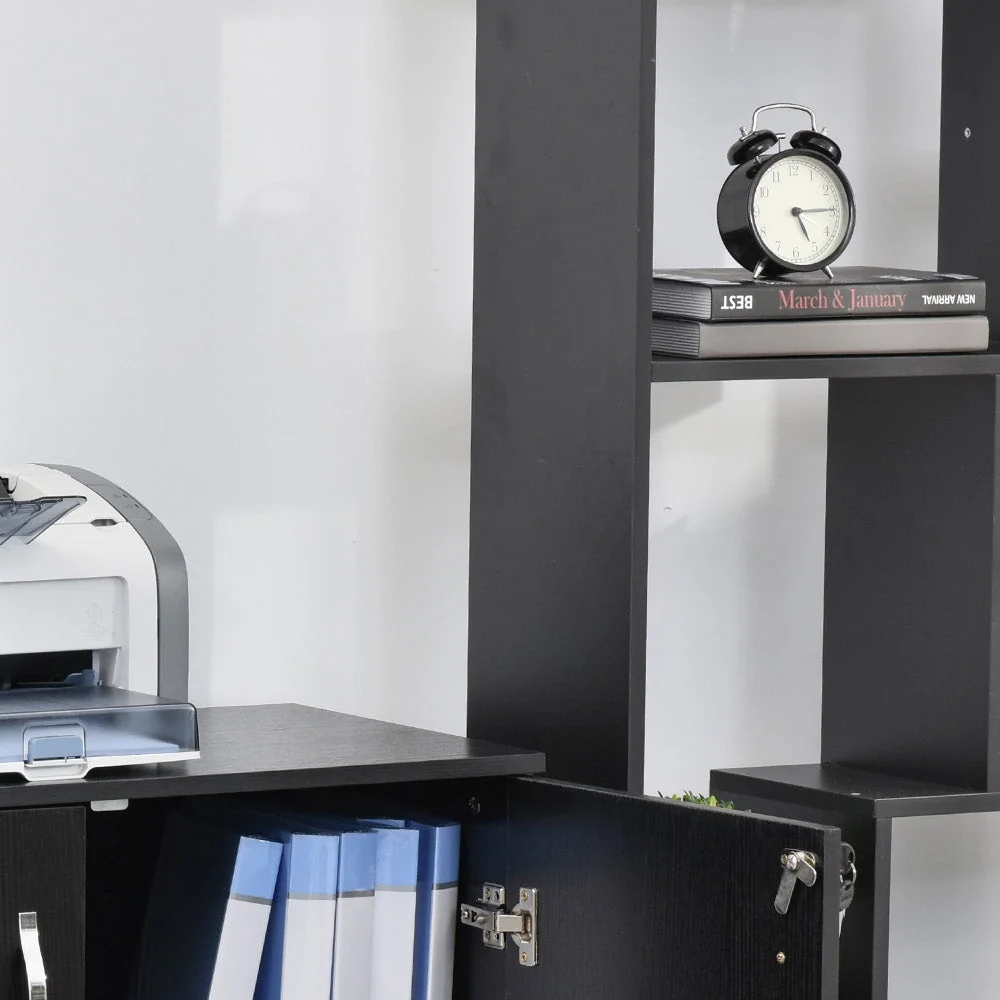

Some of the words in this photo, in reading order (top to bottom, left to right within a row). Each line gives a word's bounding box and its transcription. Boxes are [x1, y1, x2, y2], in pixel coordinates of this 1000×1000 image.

[789, 165, 799, 176] 12
[772, 171, 780, 183] 11
[759, 186, 769, 198] 10
[822, 185, 829, 196] 2
[822, 225, 829, 237] 4
[775, 241, 781, 252] 7
[792, 246, 800, 257] 6
[811, 242, 818, 252] 5
[720, 294, 753, 310] BEST
[779, 289, 828, 311] March
[832, 290, 844, 309] &
[848, 289, 907, 312] January
[921, 294, 955, 306] ARRIVAL
[955, 293, 976, 305] NEW
